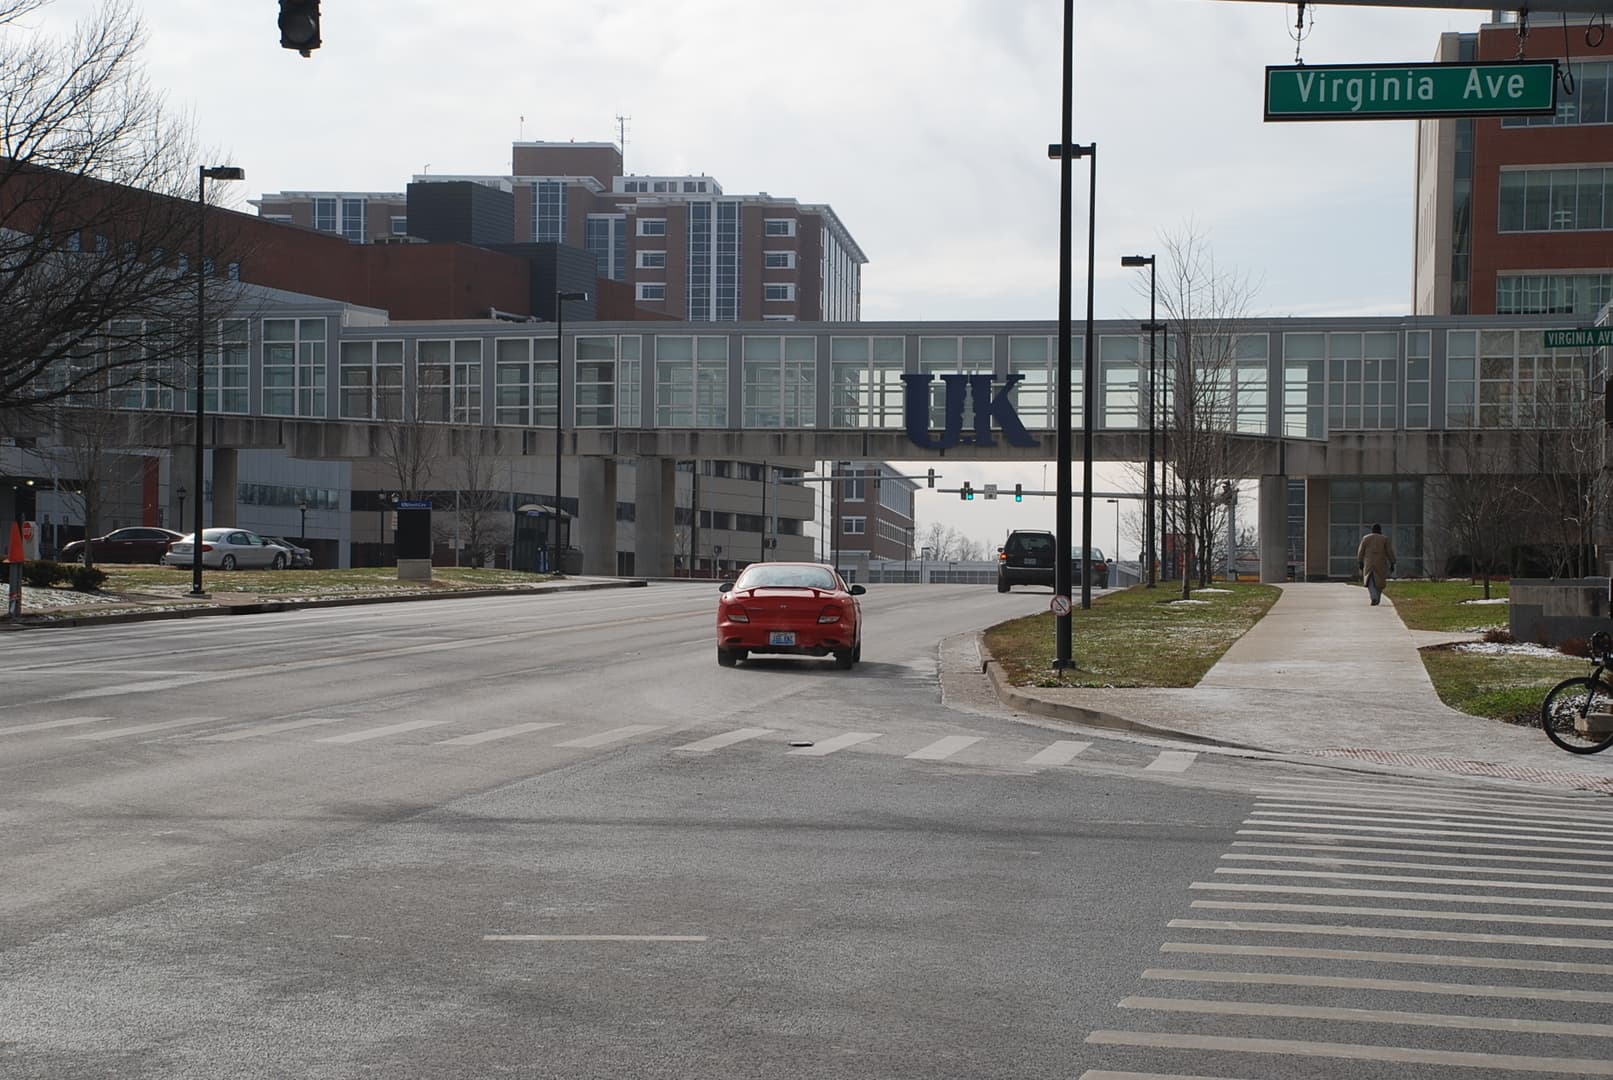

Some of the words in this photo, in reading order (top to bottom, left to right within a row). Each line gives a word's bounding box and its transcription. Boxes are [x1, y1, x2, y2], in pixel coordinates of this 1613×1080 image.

[1296, 72, 1434, 112] Virginia
[1463, 68, 1524, 99] Ave
[1547, 331, 1594, 345] VIRGINIA
[900, 374, 1041, 449] UK
